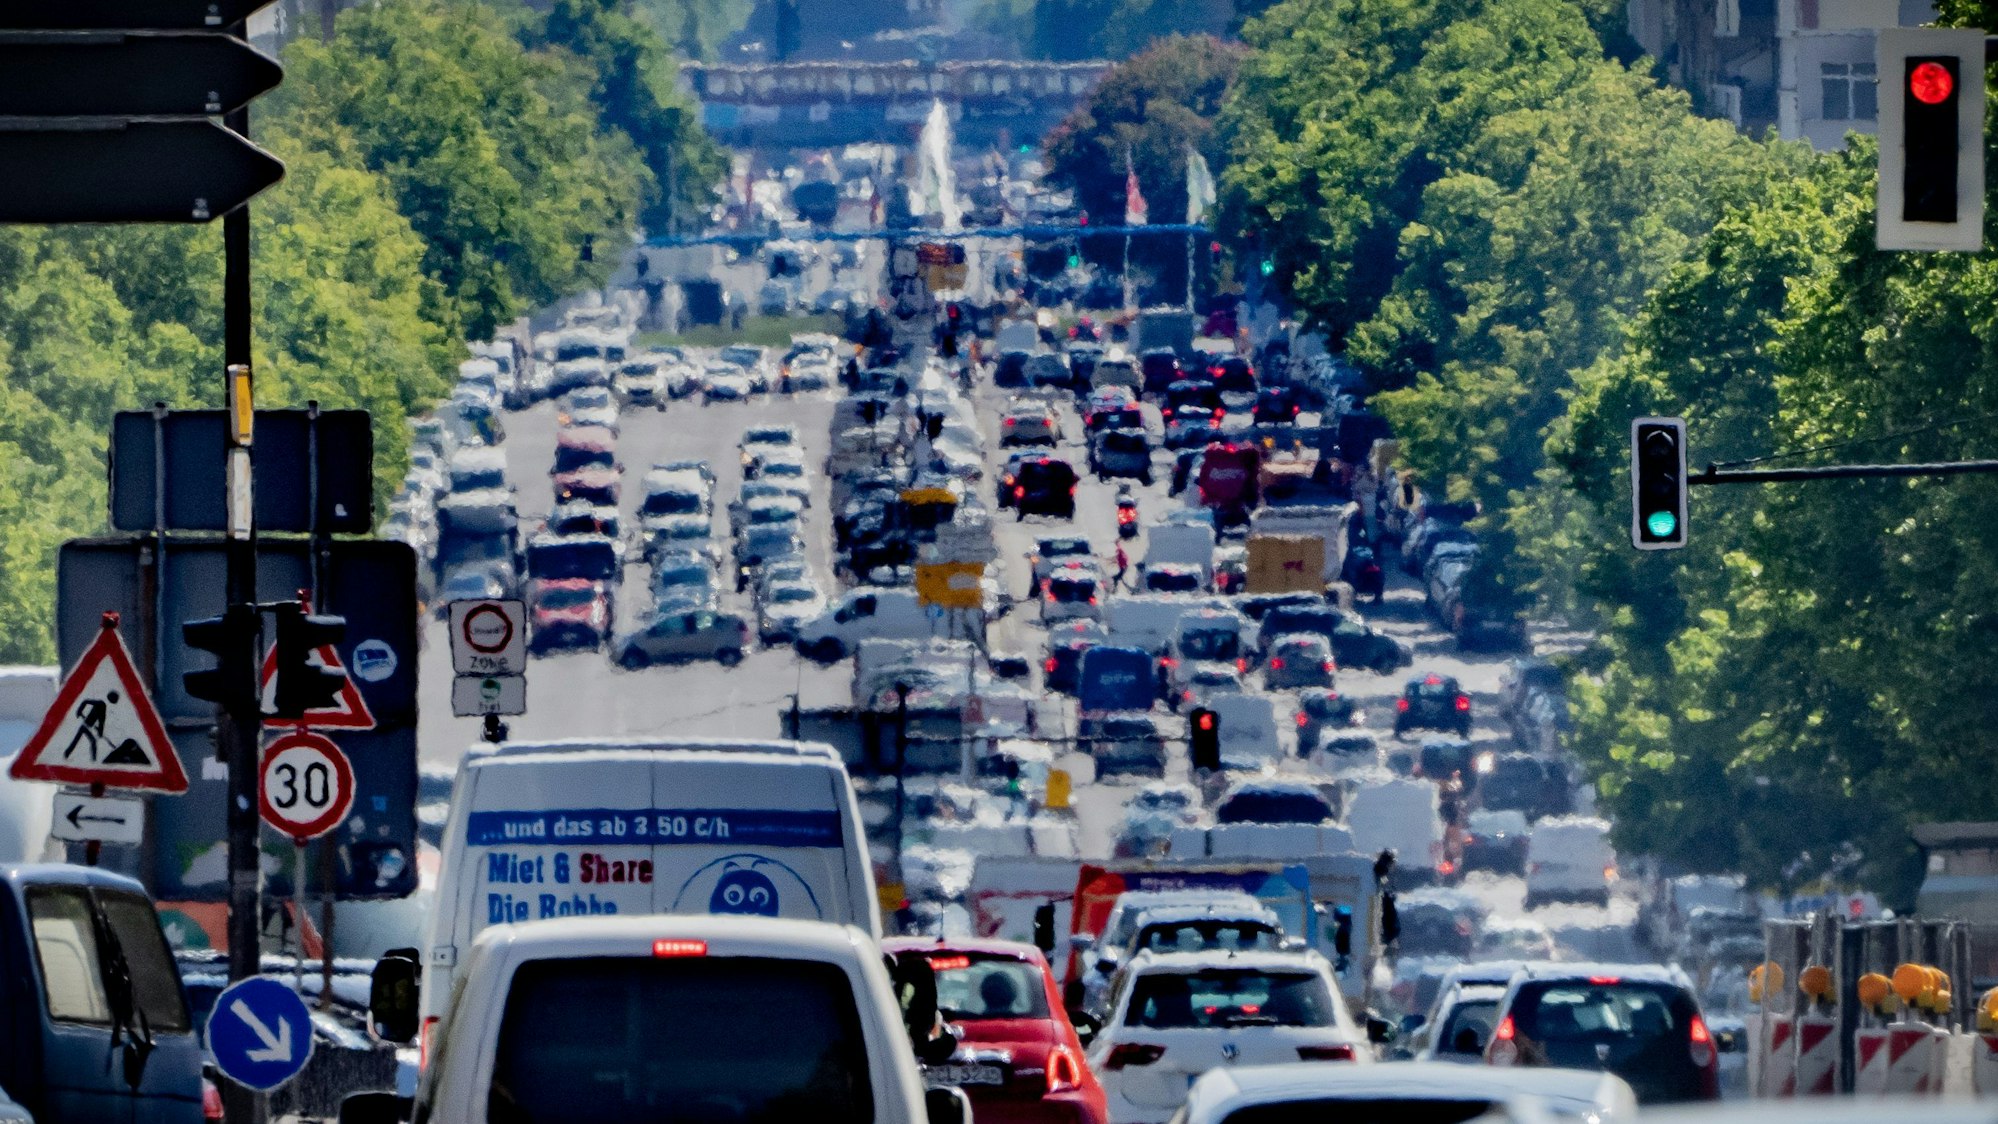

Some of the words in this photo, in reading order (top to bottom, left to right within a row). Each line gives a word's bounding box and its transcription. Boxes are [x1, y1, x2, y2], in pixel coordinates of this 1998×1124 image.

[275, 762, 329, 808] 30
[553, 815, 593, 836] das
[600, 815, 627, 836] ab
[488, 852, 544, 883] Miet
[554, 852, 570, 883] &
[580, 852, 654, 883] Share
[488, 893, 528, 923] Die
